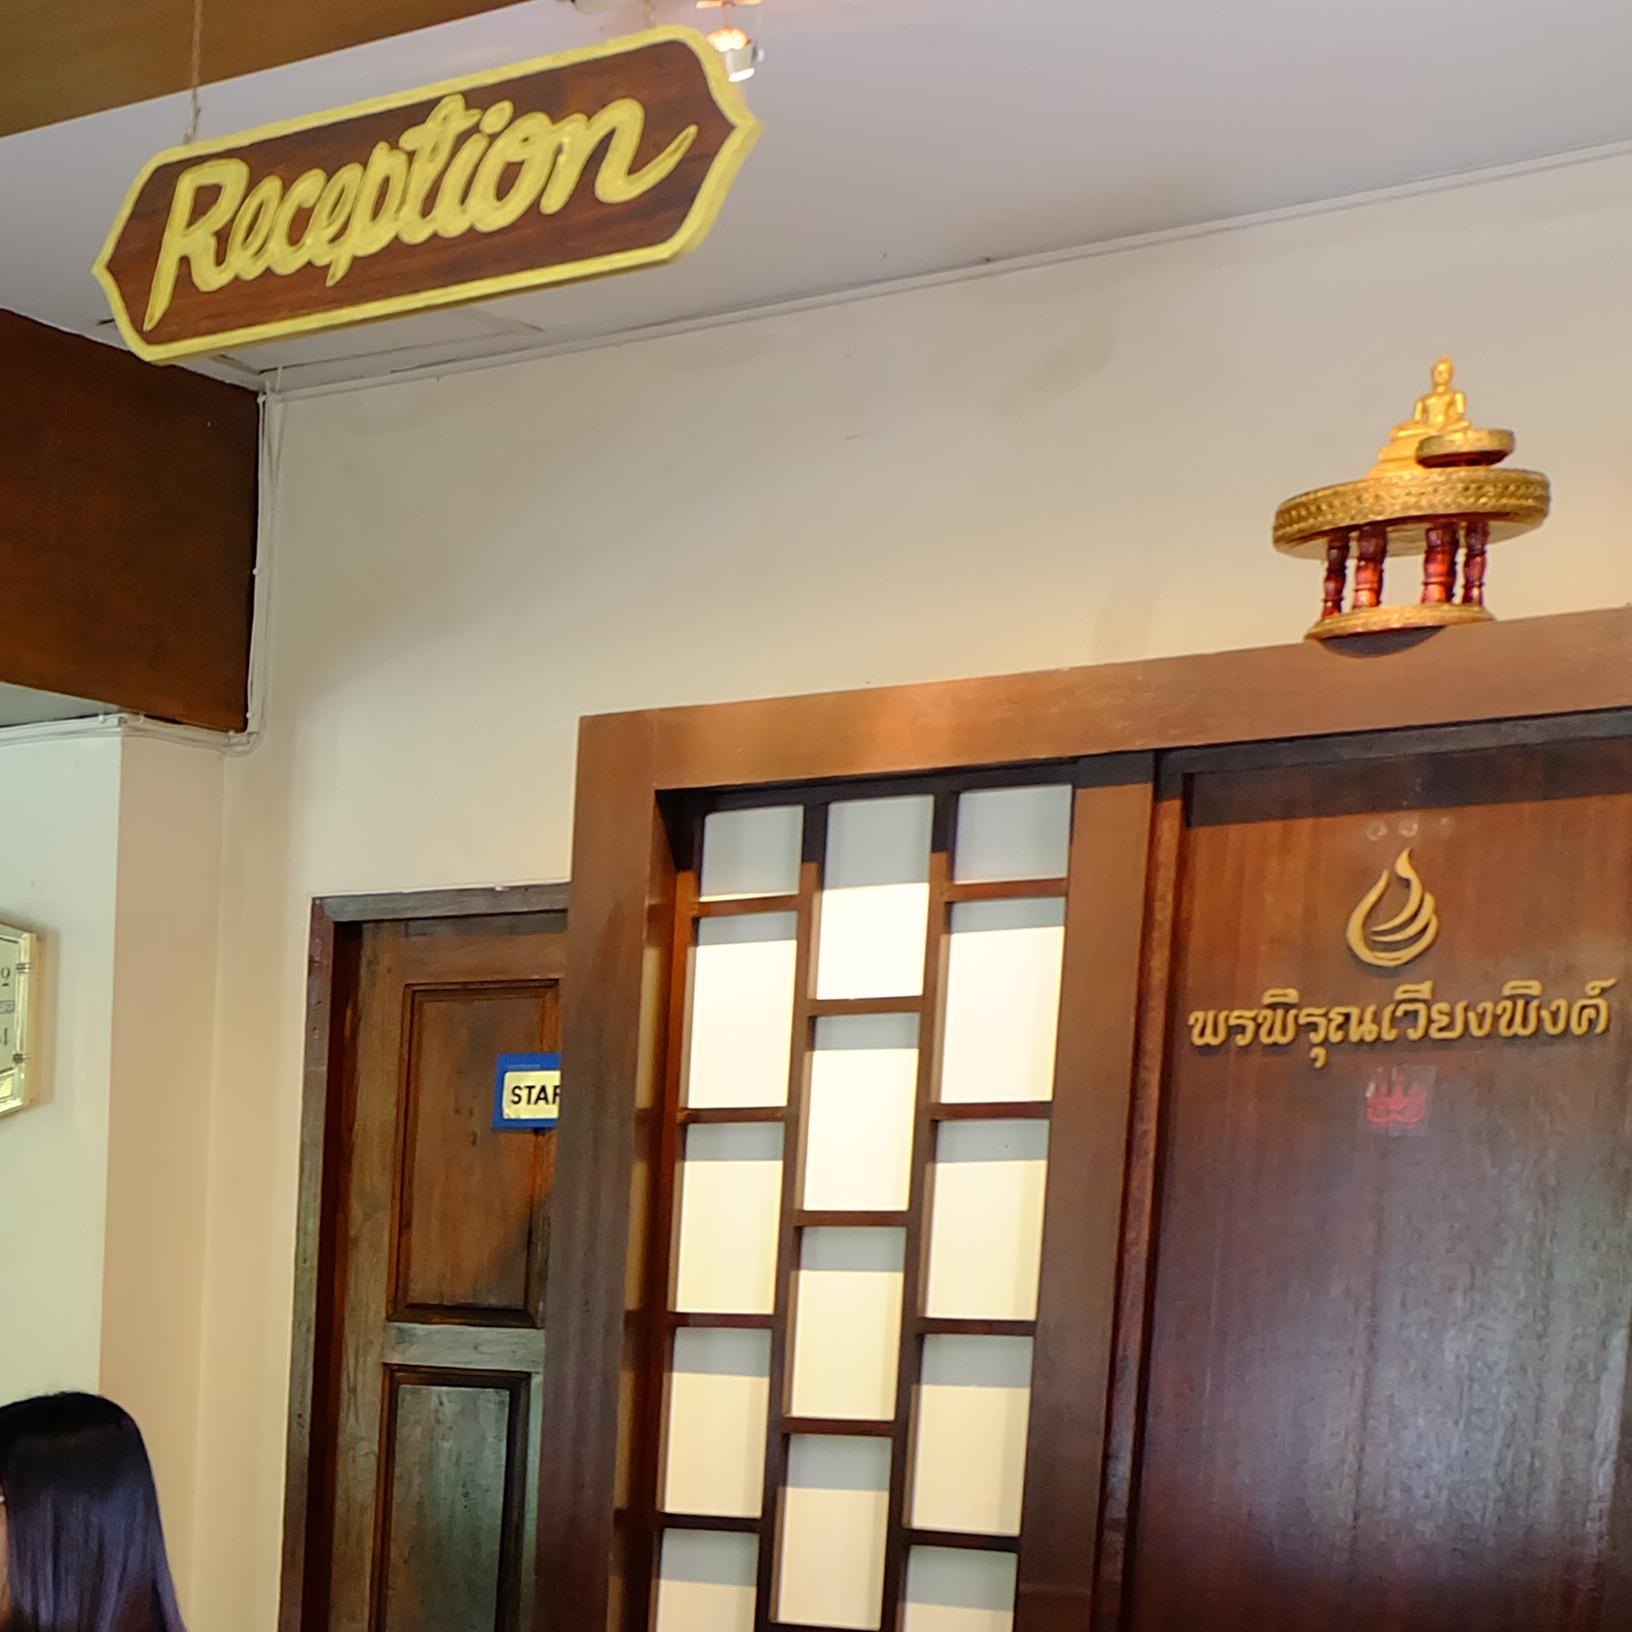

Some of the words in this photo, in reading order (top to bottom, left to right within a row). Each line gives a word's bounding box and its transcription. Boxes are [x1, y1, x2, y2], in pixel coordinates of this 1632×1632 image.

[142, 94, 697, 331] Reception
[1188, 978, 1617, 1068] พรพิรุณเวียงพิงค์
